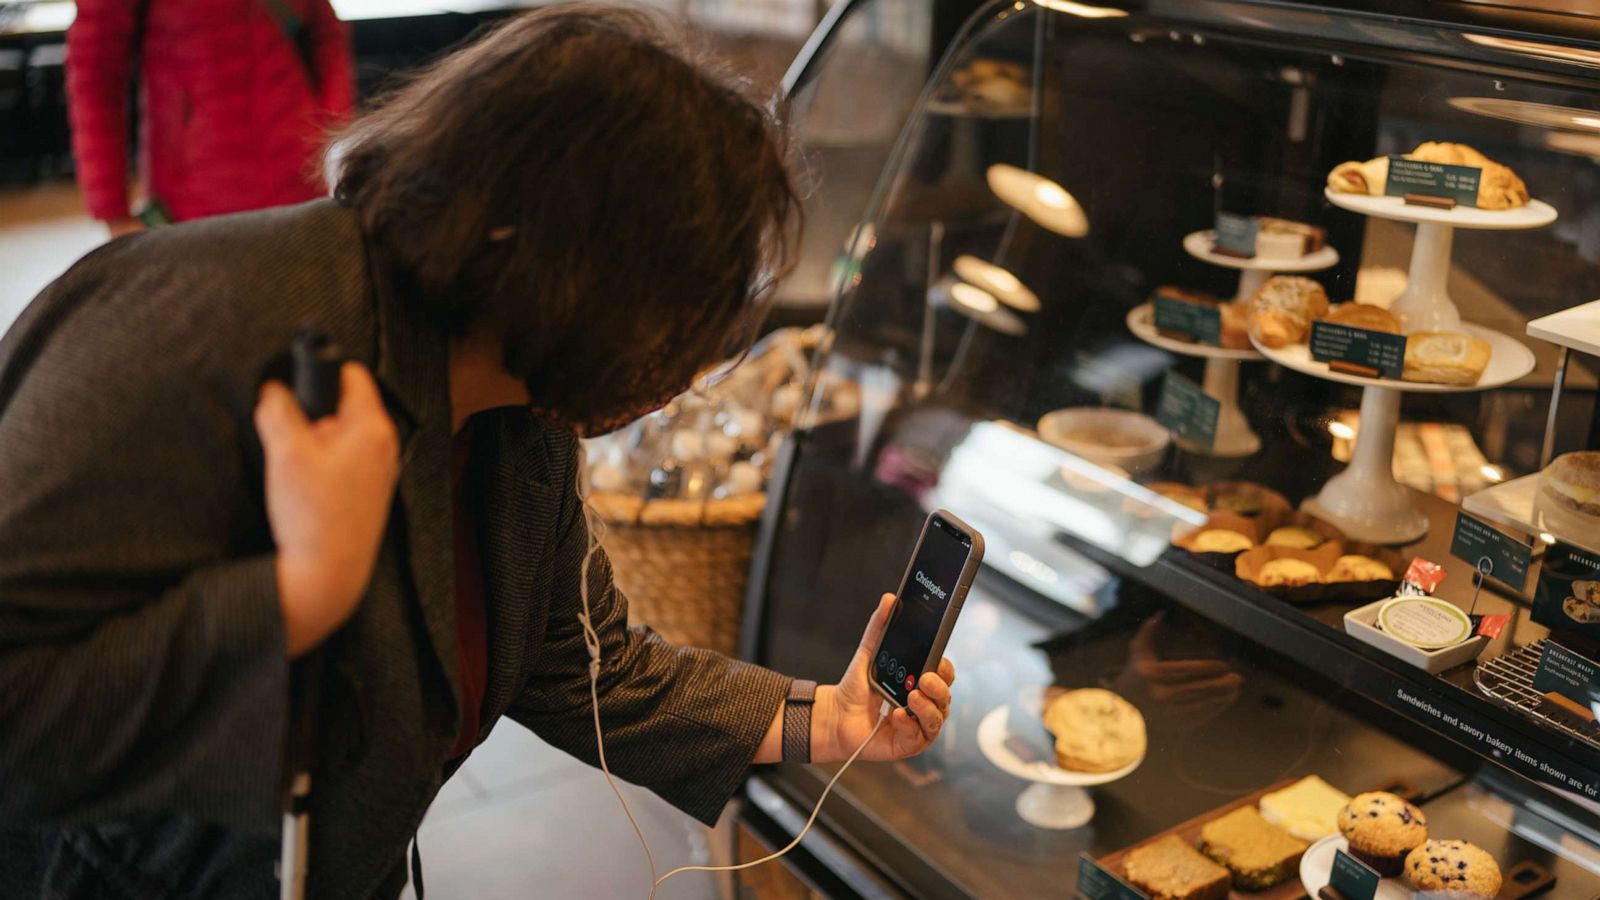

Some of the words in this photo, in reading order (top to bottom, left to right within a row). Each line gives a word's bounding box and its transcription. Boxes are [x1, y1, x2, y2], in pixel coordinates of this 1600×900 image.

[915, 570, 947, 600] Christopher
[1549, 649, 1576, 665] BREAKFAST
[1577, 663, 1594, 676] WRAPS
[1396, 688, 1441, 717] Sandwiches
[1442, 713, 1459, 727] and
[1459, 722, 1485, 741] savory
[1486, 734, 1513, 755] bakery
[1514, 748, 1538, 767] items
[1539, 762, 1566, 782] shown
[1568, 777, 1583, 790] are
[1584, 784, 1598, 797] for
